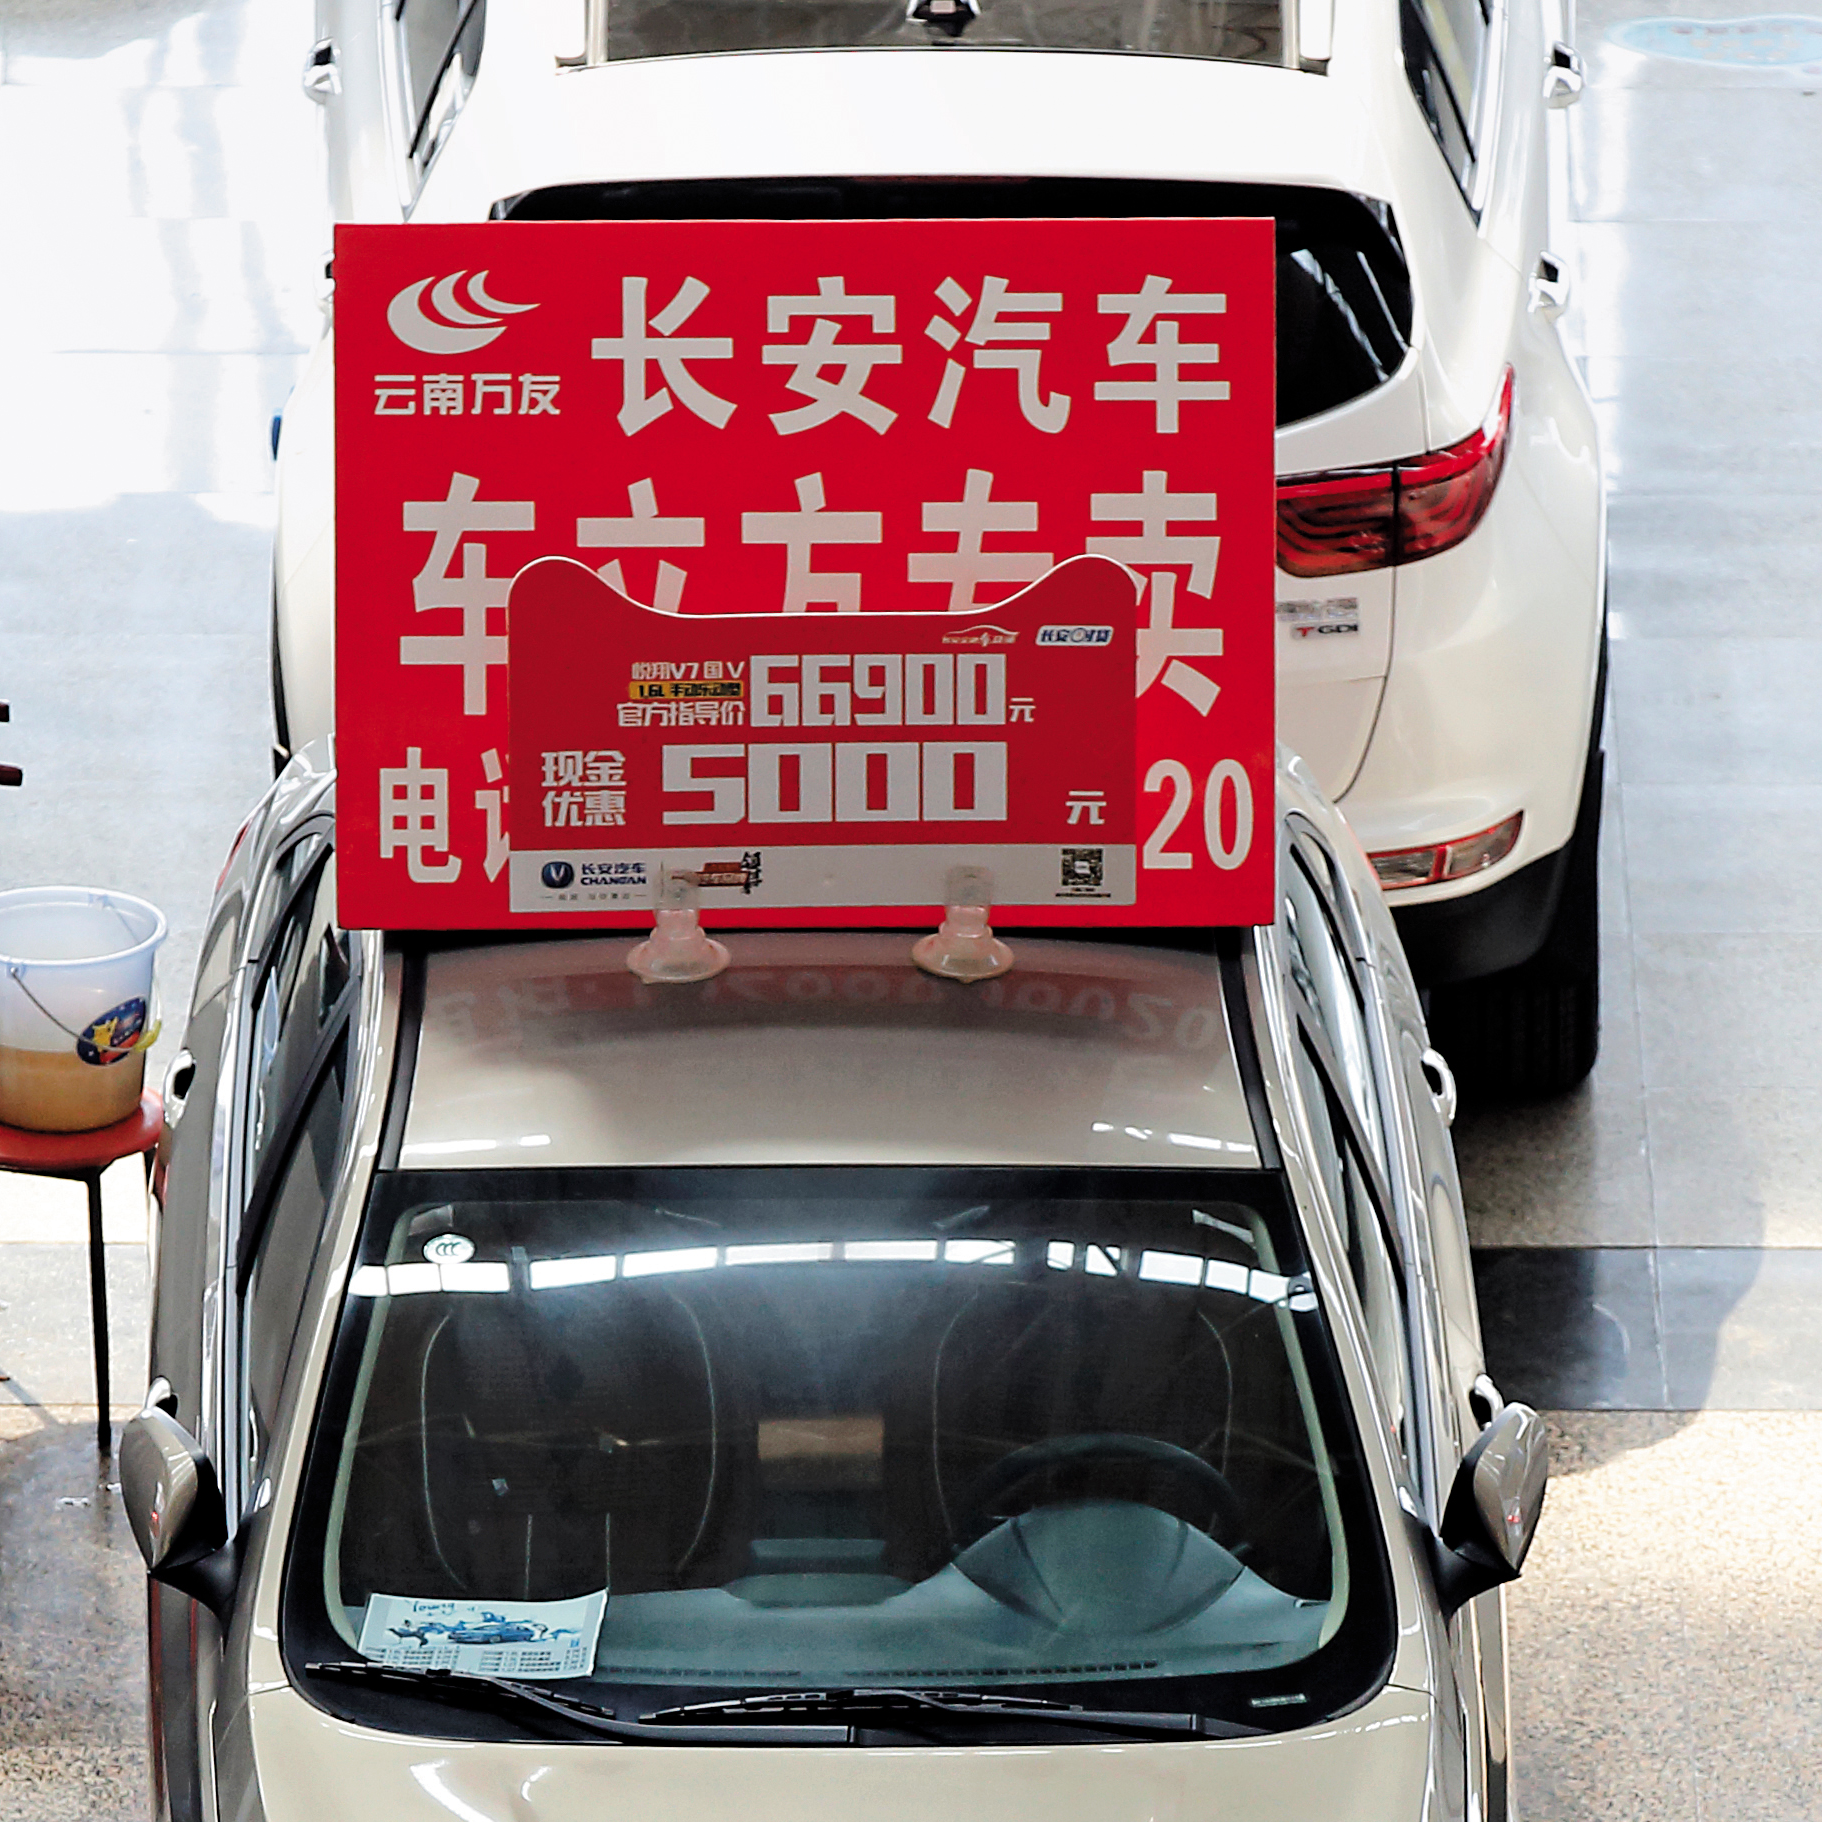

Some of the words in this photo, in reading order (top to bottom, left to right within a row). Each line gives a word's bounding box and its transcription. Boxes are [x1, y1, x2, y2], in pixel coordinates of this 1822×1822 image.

[592, 275, 1230, 436] 长安汽车
[375, 374, 560, 415] 云南万友
[617, 701, 745, 727] 官方指导价
[751, 654, 1005, 726] 66900
[1009, 697, 1035, 723] 元
[542, 751, 626, 787] 现金
[663, 742, 1007, 824] 5000
[1067, 791, 1106, 825] 元
[543, 789, 626, 827] 优惠
